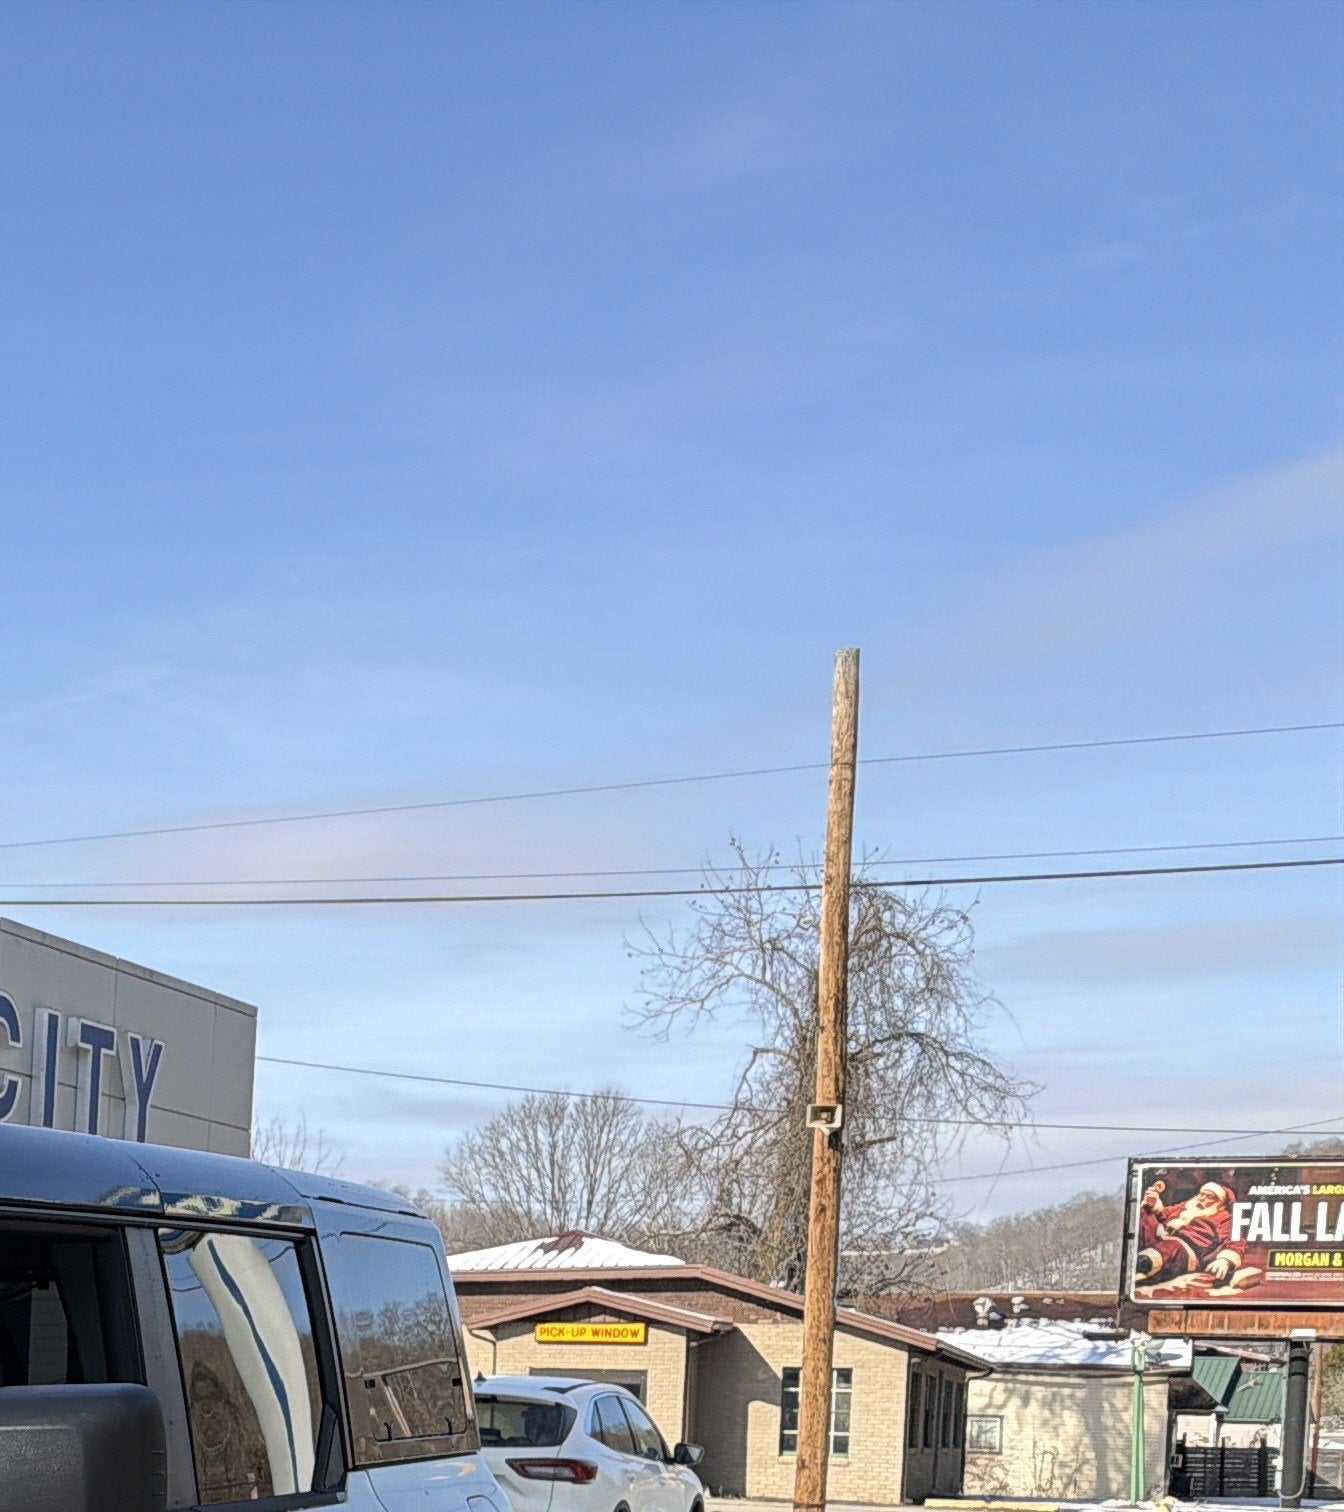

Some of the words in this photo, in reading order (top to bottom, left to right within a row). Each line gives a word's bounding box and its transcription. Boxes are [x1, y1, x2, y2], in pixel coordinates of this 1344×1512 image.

[1231, 1201, 1309, 1242] FALL
[1274, 1252, 1331, 1267] MORGAN
[1332, 1252, 1343, 1267] &
[539, 1326, 587, 1338] PICK-UP
[591, 1327, 641, 1339] WINDOW
